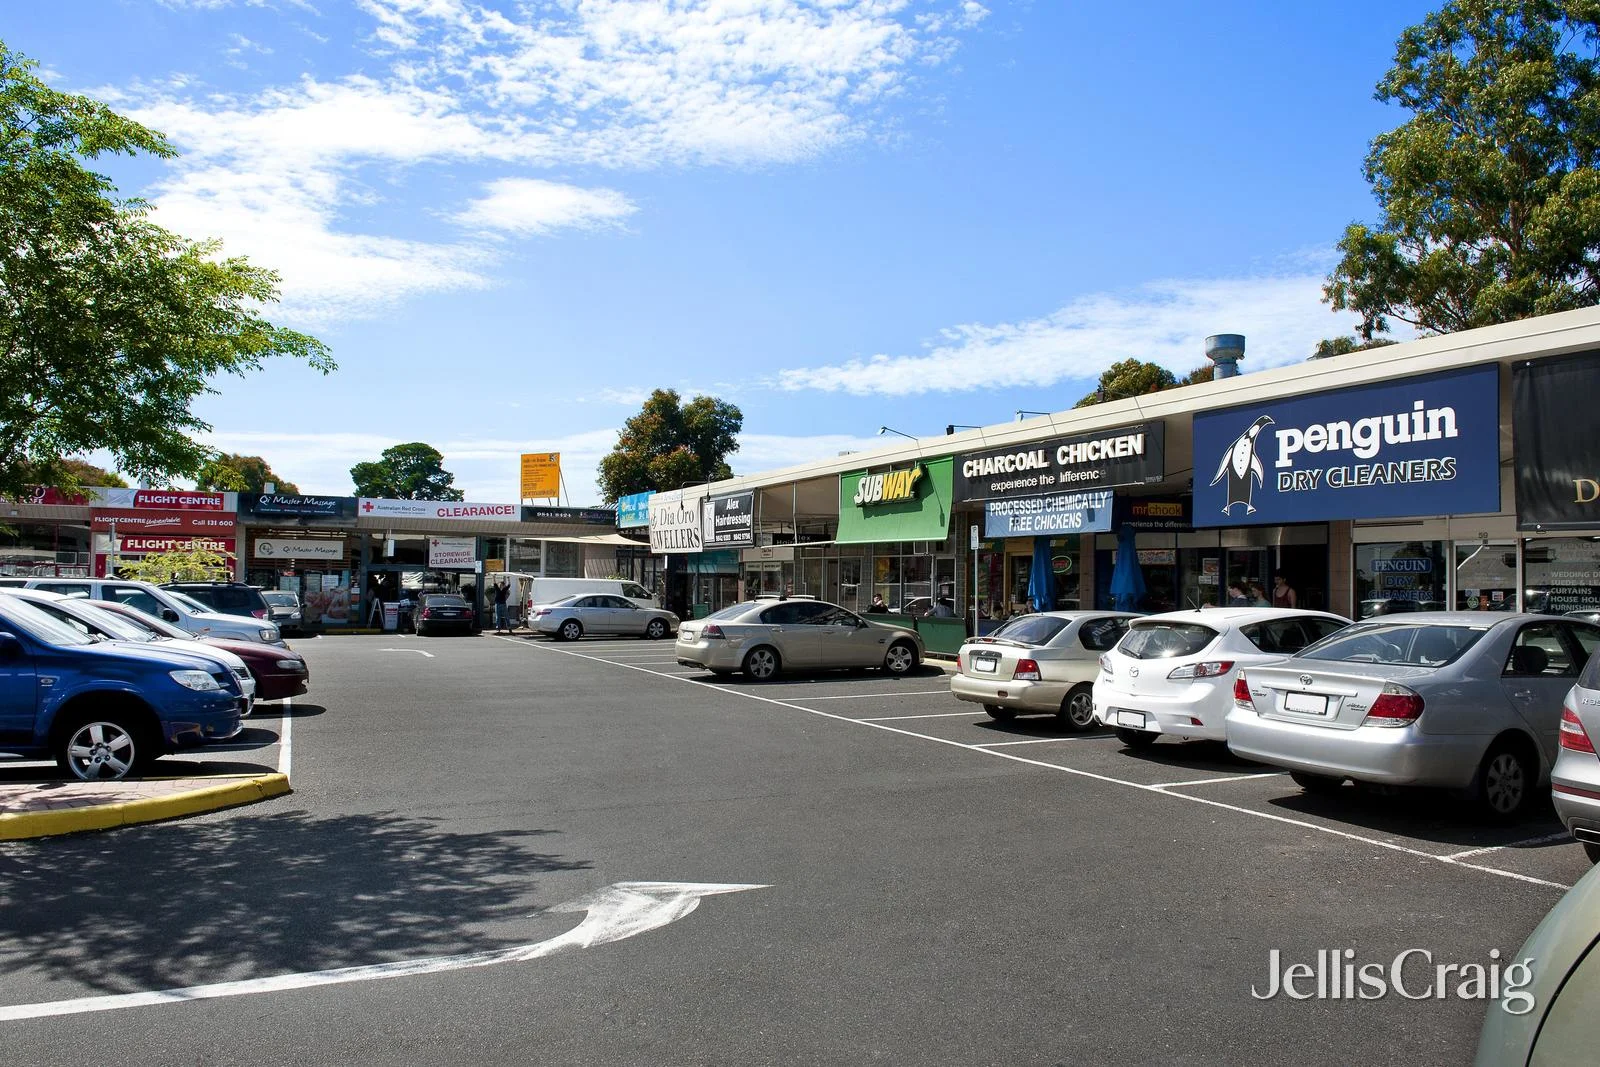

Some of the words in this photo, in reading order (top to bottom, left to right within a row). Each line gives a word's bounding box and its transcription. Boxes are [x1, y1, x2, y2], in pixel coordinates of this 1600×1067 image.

[1275, 400, 1458, 468] penguin
[963, 450, 1049, 478] CHARCOAL
[1057, 434, 1144, 465] CHICKEN
[1040, 474, 1054, 485] the
[1277, 469, 1322, 492] DRY
[1326, 457, 1456, 488] CLEANERS
[854, 466, 921, 504] SUBWAY
[138, 495, 177, 504] FLIGHT
[179, 496, 220, 505] CENTRE
[273, 496, 301, 505] Master
[303, 497, 337, 509] Massage
[726, 498, 739, 510] Alex
[991, 499, 1043, 516] PROCESSED
[1046, 491, 1108, 513] CHEMICALLY
[437, 505, 516, 517] CLEARANCE!
[660, 506, 674, 526] Dia
[677, 507, 694, 524] Oro
[715, 512, 751, 527] Hairdressing
[1009, 516, 1032, 532] FREE
[1034, 513, 1082, 530] CHICKENS
[127, 539, 172, 549] FLIGHT
[179, 540, 226, 550] CENTRE
[430, 558, 475, 566] CLEARANCE!
[1375, 560, 1426, 571] PENGUIN
[1386, 575, 1415, 587] DRY
[1369, 591, 1434, 601] CLEANERS
